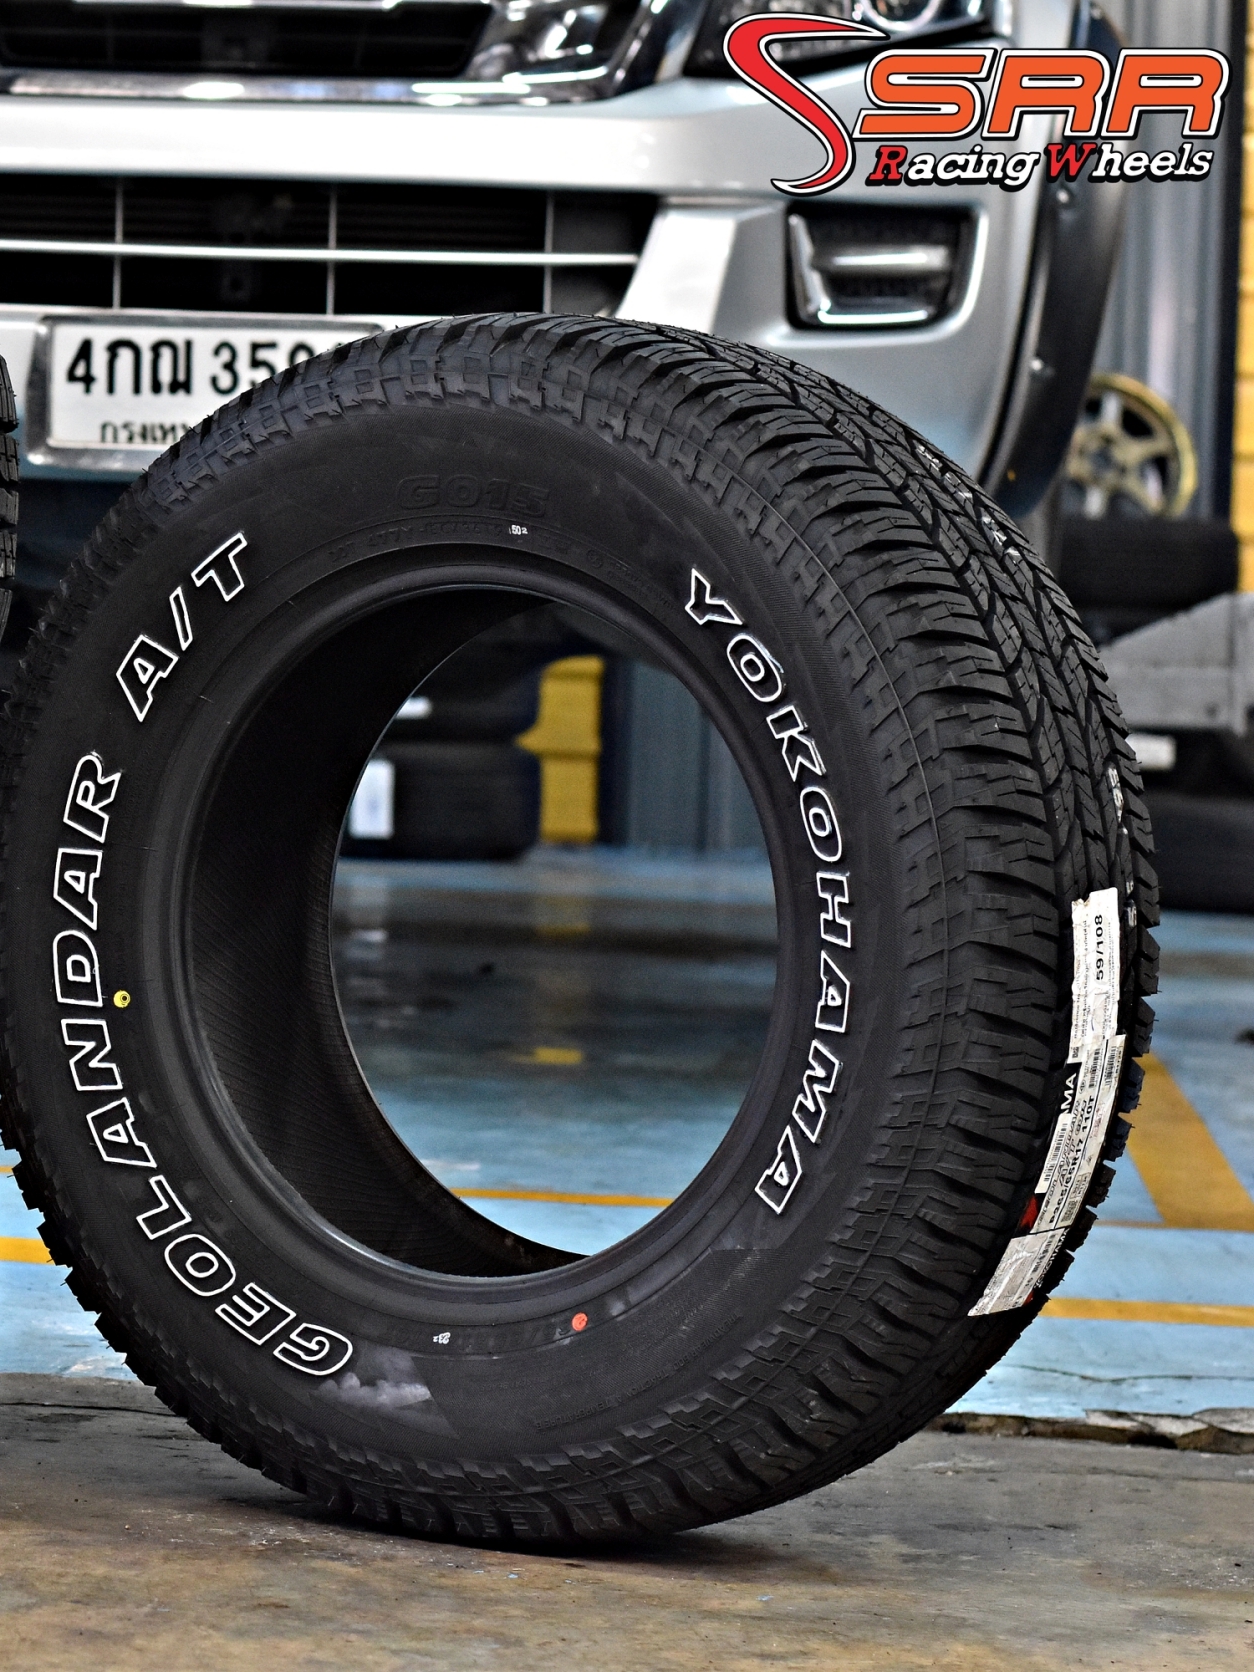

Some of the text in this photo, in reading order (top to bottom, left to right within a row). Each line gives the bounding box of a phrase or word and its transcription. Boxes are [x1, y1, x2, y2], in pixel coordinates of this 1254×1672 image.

[53, 531, 354, 1376] GEOLANDAR A/T
[684, 566, 851, 1216] YOKOHAMA
[1094, 914, 1104, 981] 59/108
[1049, 1137, 1083, 1224] P265/65R17
[1082, 1095, 1095, 1133] 110T
